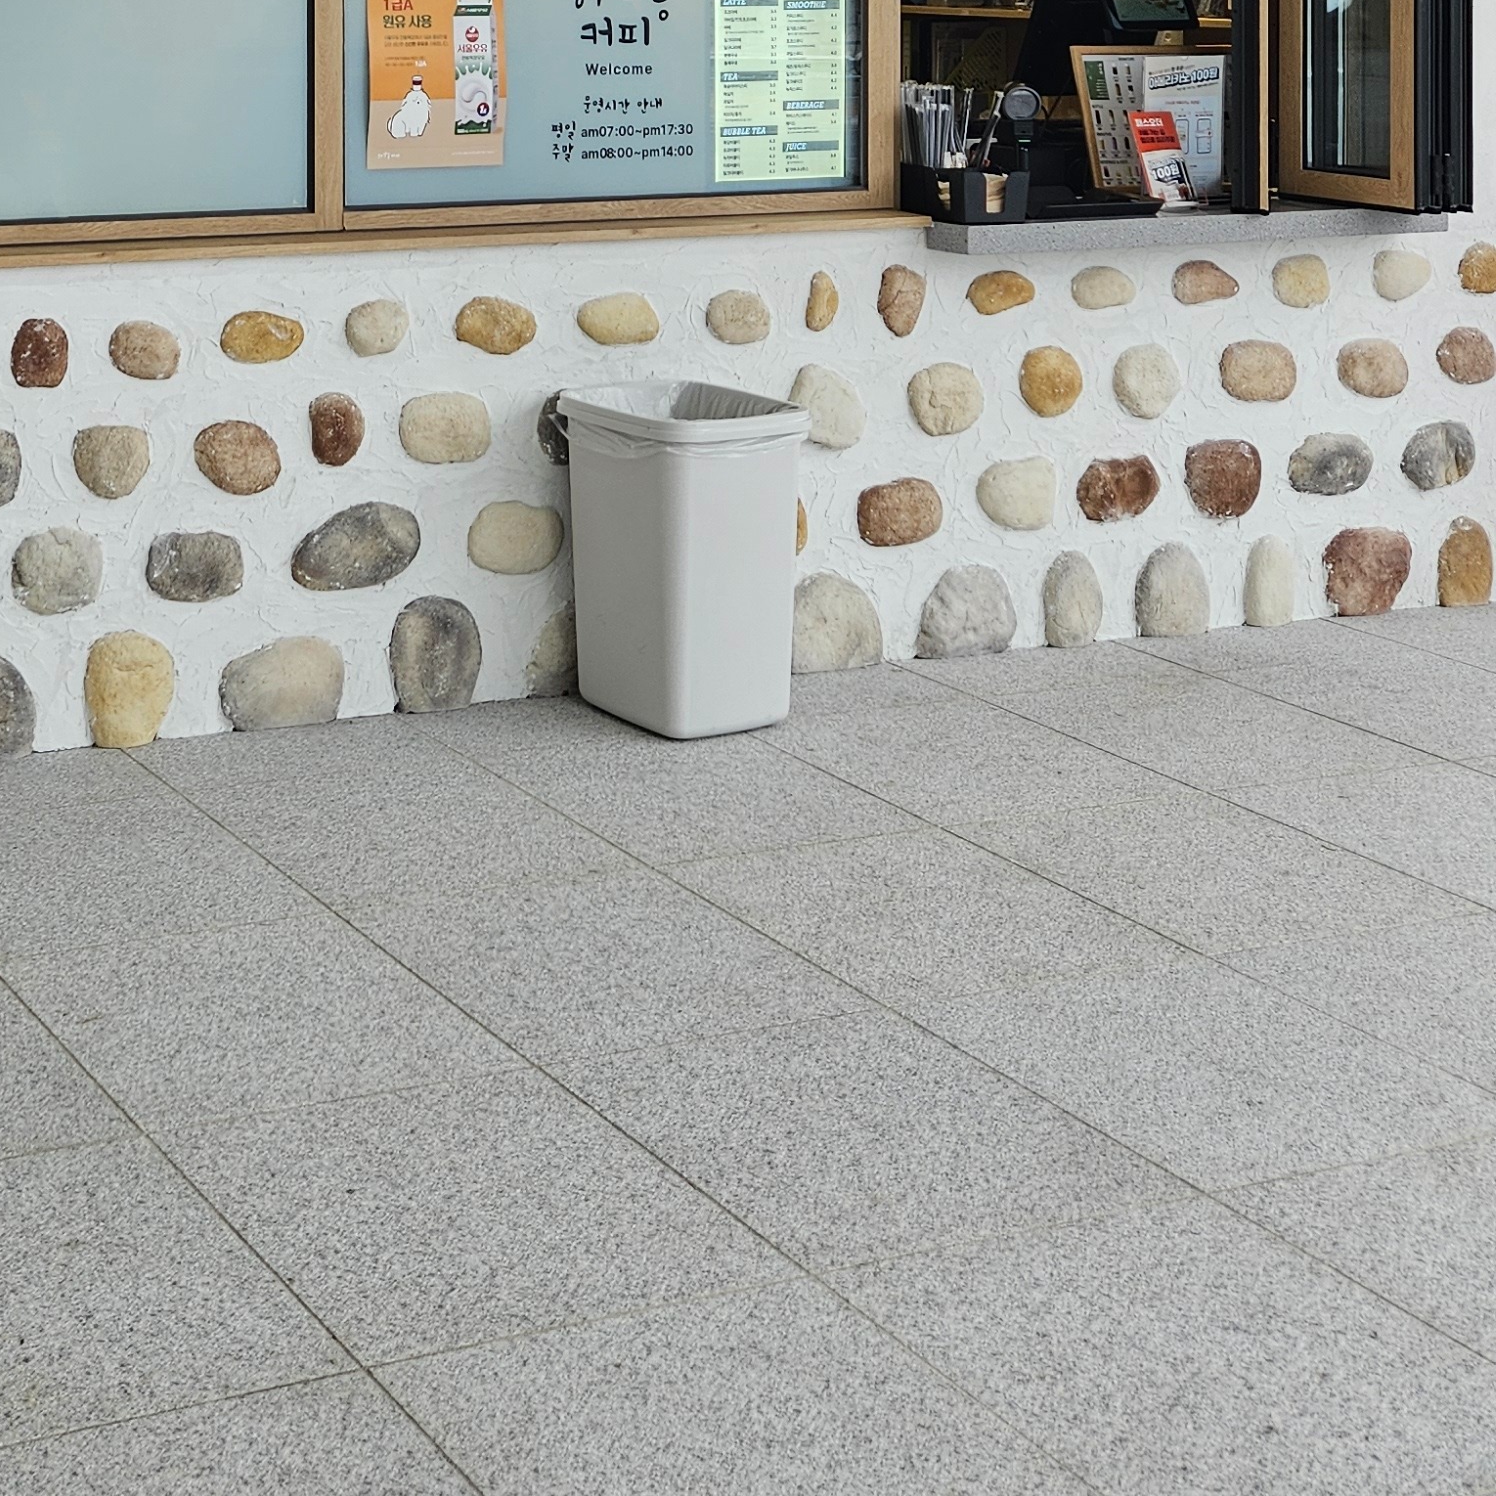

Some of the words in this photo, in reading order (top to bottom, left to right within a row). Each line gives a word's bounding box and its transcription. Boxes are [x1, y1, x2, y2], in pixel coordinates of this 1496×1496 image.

[383, 15, 405, 28] 원유
[409, 15, 432, 28] 사용
[580, 17, 650, 46] 커피
[457, 44, 488, 53] 서울우유
[585, 63, 653, 75] Welcome
[723, 73, 738, 81] TEA
[584, 96, 630, 114] 운영시간
[636, 98, 662, 114] 안내
[551, 120, 576, 140] 평일
[581, 124, 694, 138] am07:00~pm17:30
[723, 128, 750, 136] BUBBLE
[552, 143, 574, 162] 주말
[581, 145, 694, 160] am08:00~pm14:00
[785, 142, 807, 151] JUICE
